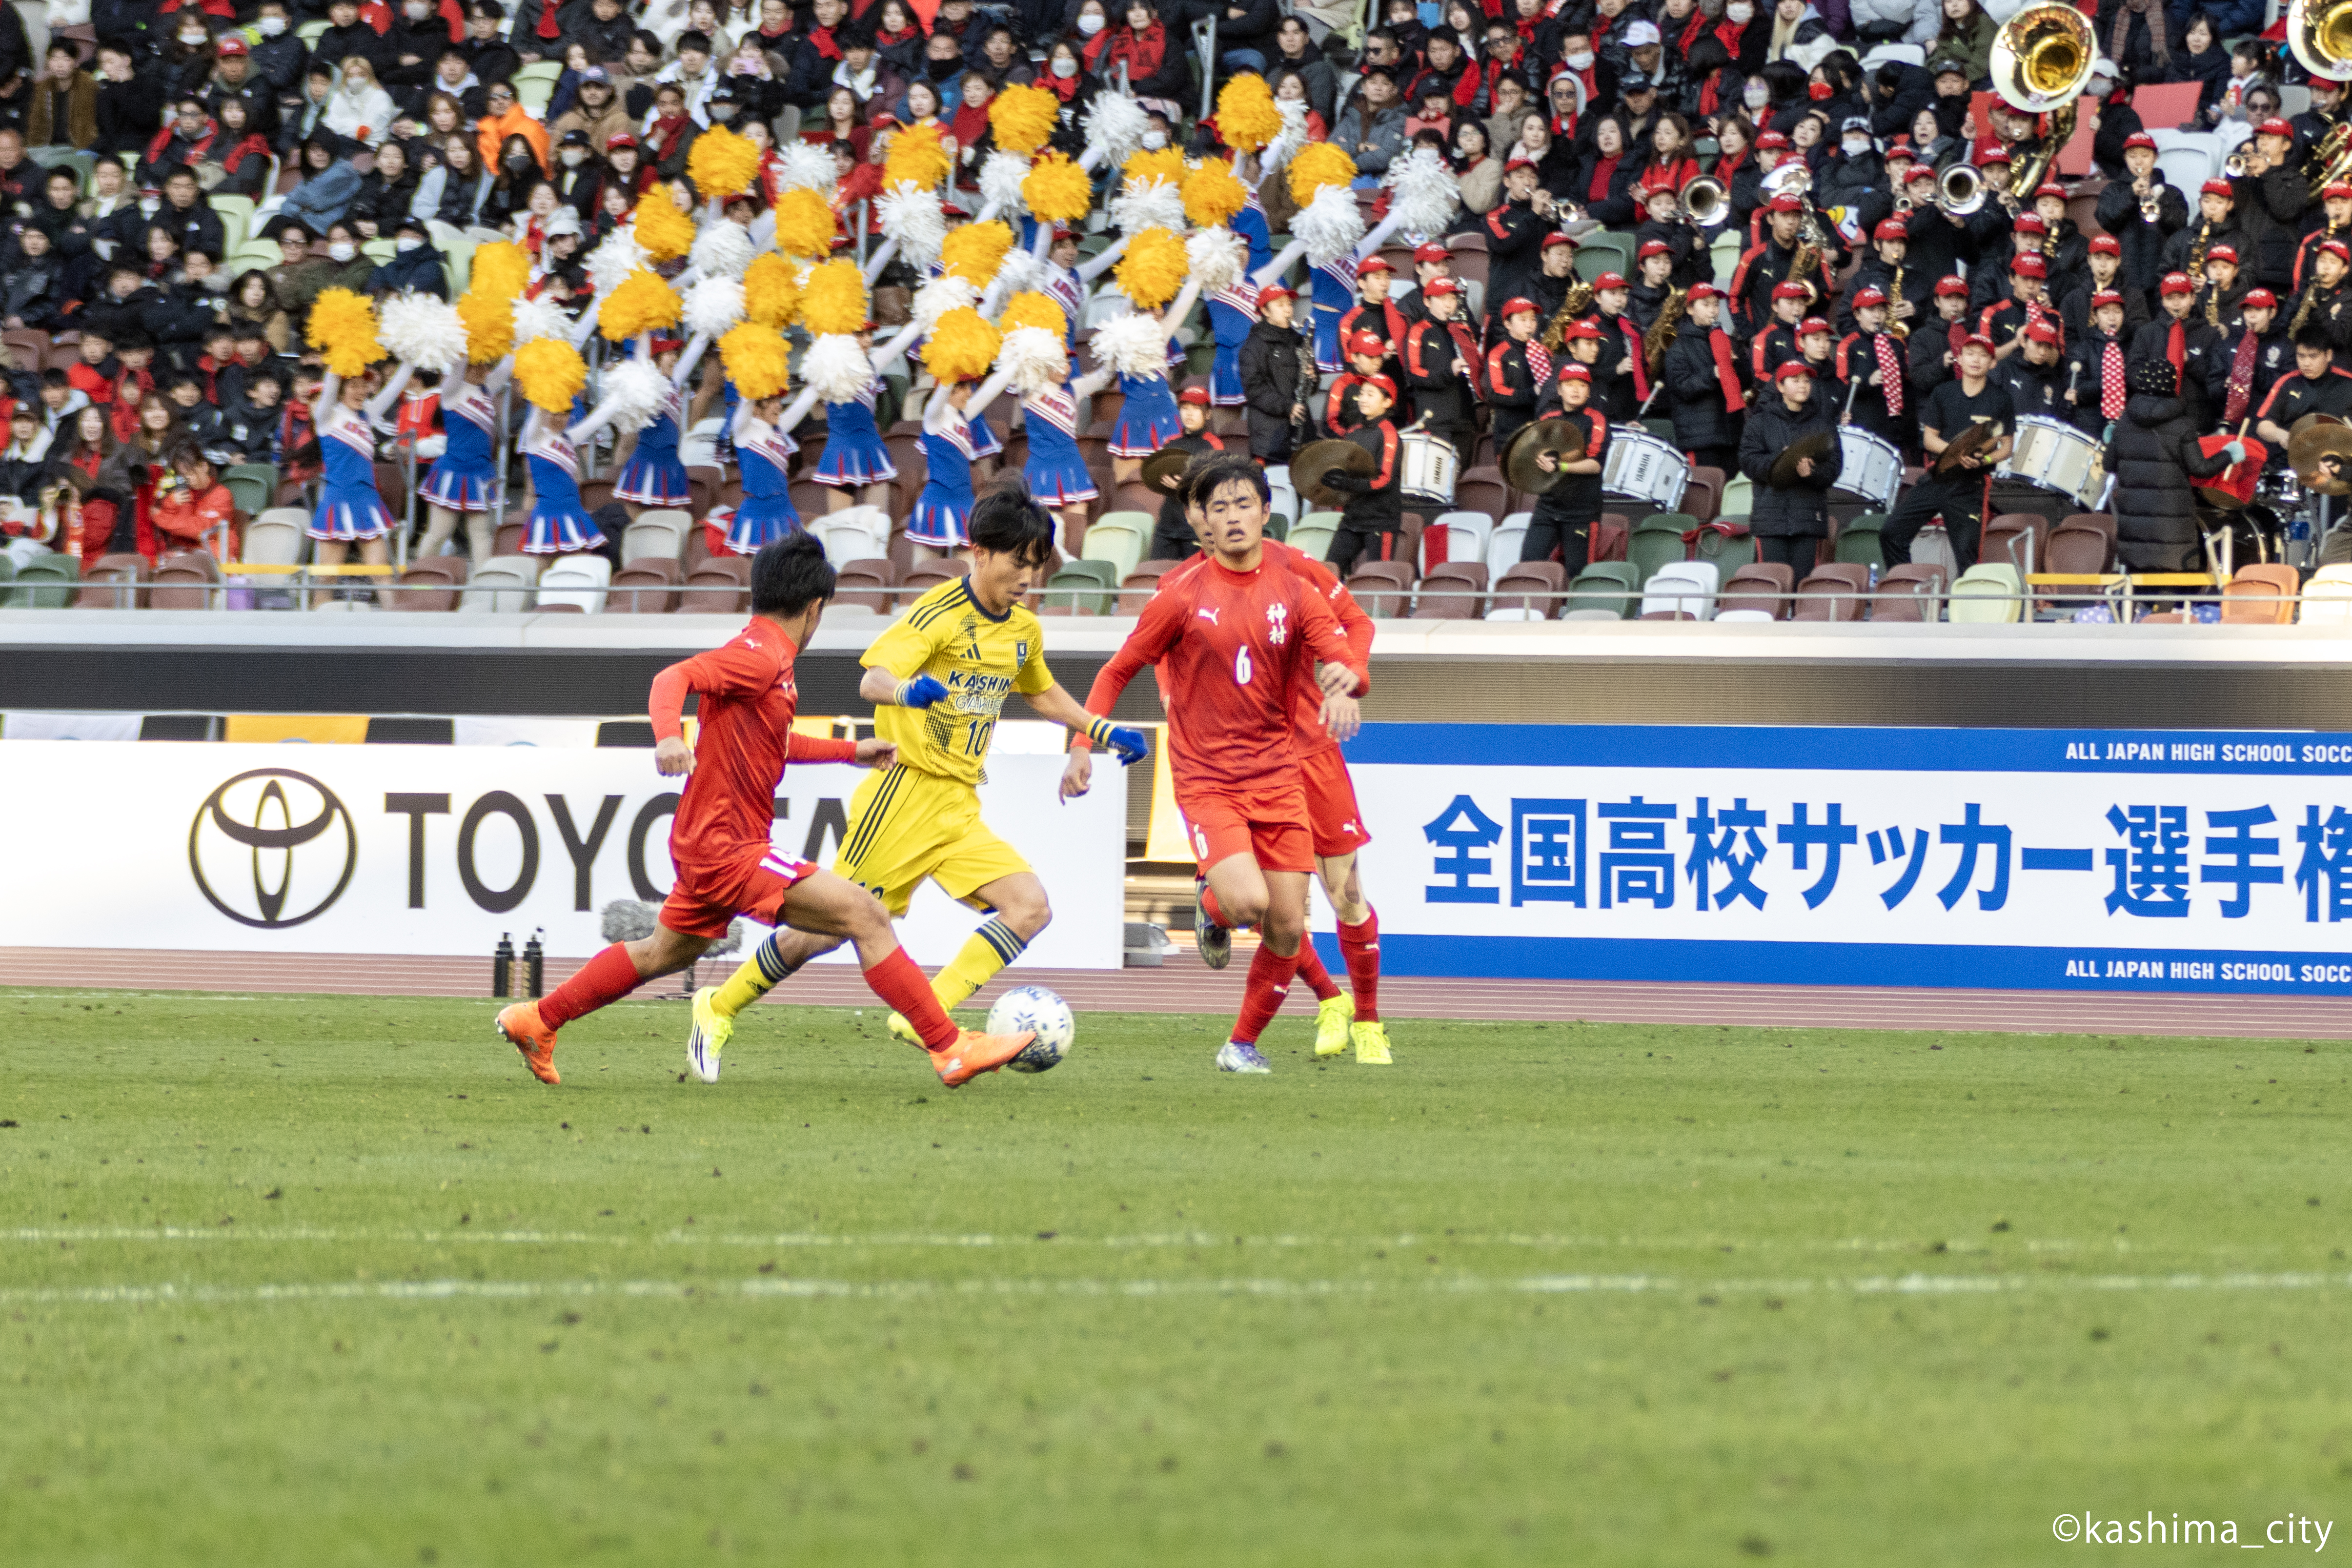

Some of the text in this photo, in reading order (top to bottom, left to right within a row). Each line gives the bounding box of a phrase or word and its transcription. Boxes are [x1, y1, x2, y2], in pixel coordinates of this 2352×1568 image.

[1433, 456, 1443, 485] YAMAHA
[1635, 454, 1651, 483] YAMAHA
[1266, 602, 1287, 645] 神村
[1236, 645, 1251, 684] 6
[965, 720, 991, 756] 10
[2066, 742, 2352, 763] ALL JAPAN HIGH SCHOOL SOCC
[385, 790, 849, 914] TOYOA
[1194, 823, 1209, 860] 6
[1422, 794, 2352, 922] 全国高校サッカー選手権
[2065, 959, 2352, 983] ALL JAPAN HIGH SCHOOL SOCC
